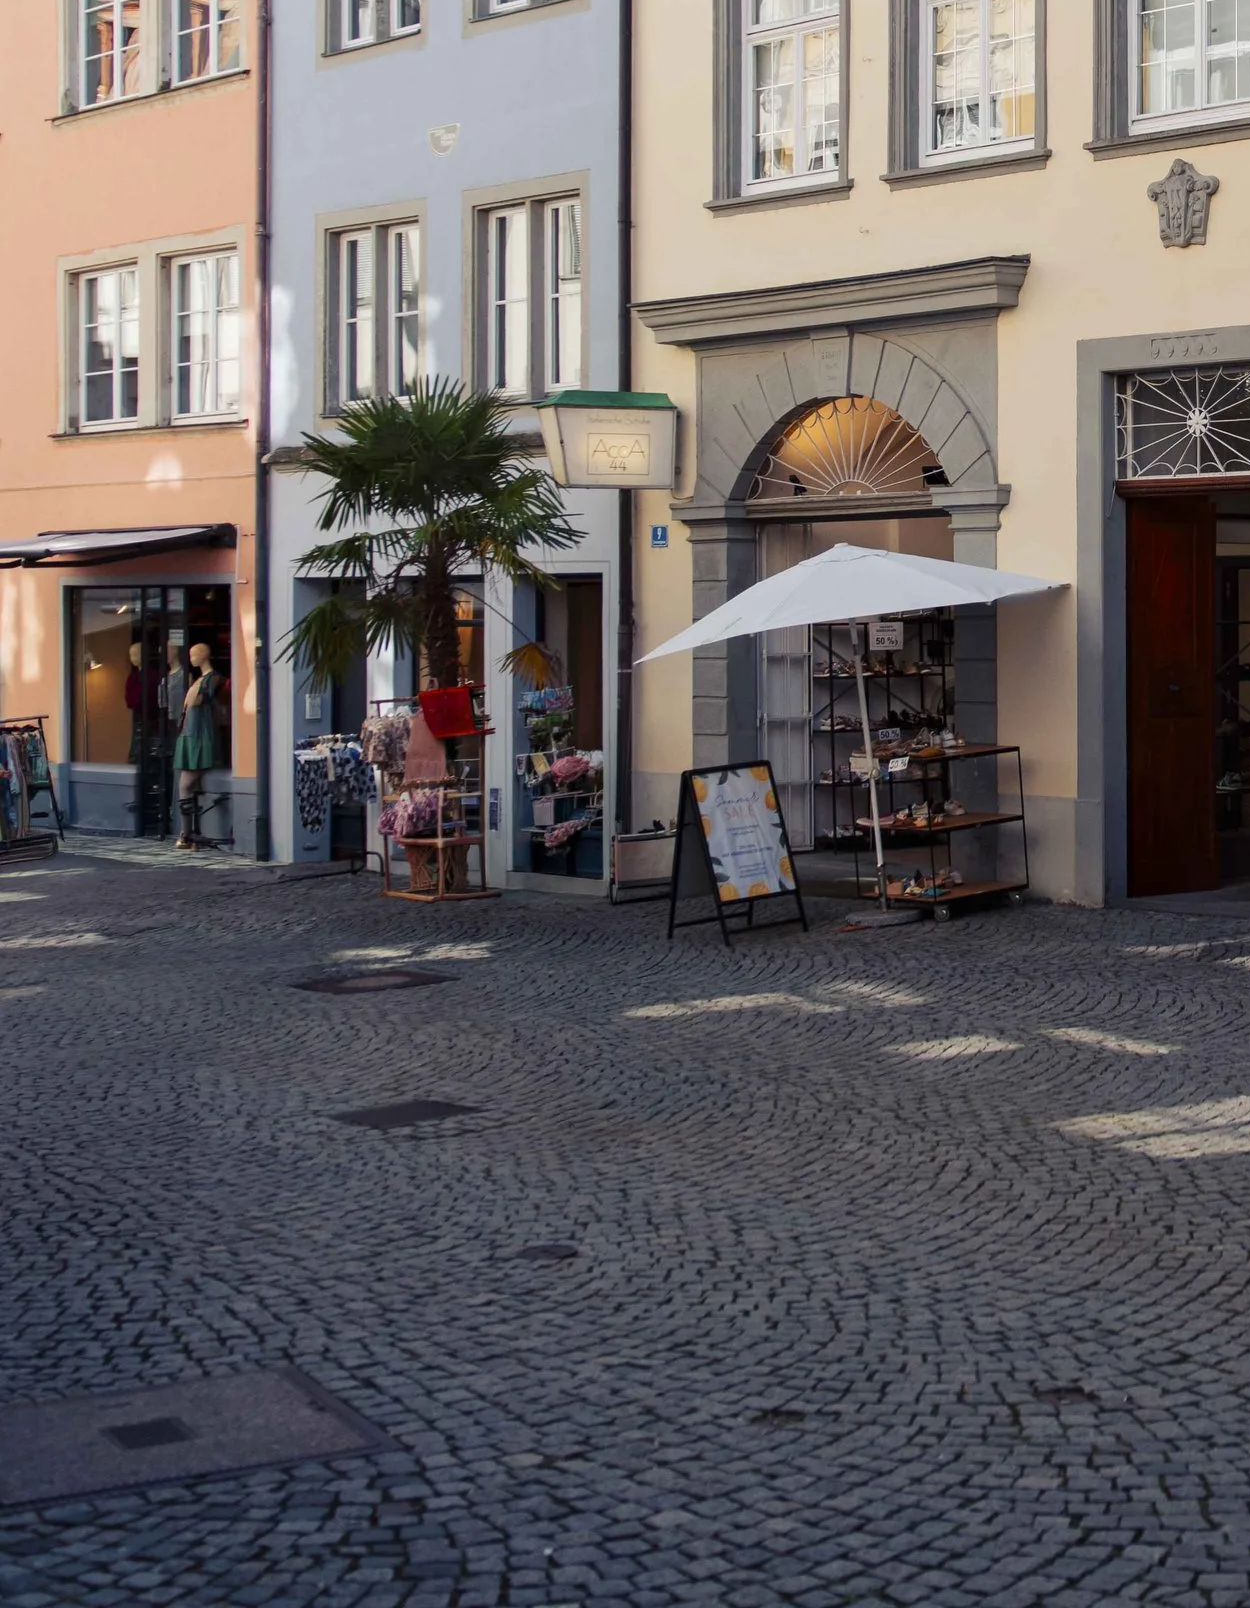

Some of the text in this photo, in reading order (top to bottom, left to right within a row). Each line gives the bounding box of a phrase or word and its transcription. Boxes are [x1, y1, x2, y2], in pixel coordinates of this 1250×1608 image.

[609, 459, 628, 472] 44
[656, 527, 662, 540] 9
[876, 636, 885, 645] 50
[880, 730, 890, 739] 50
